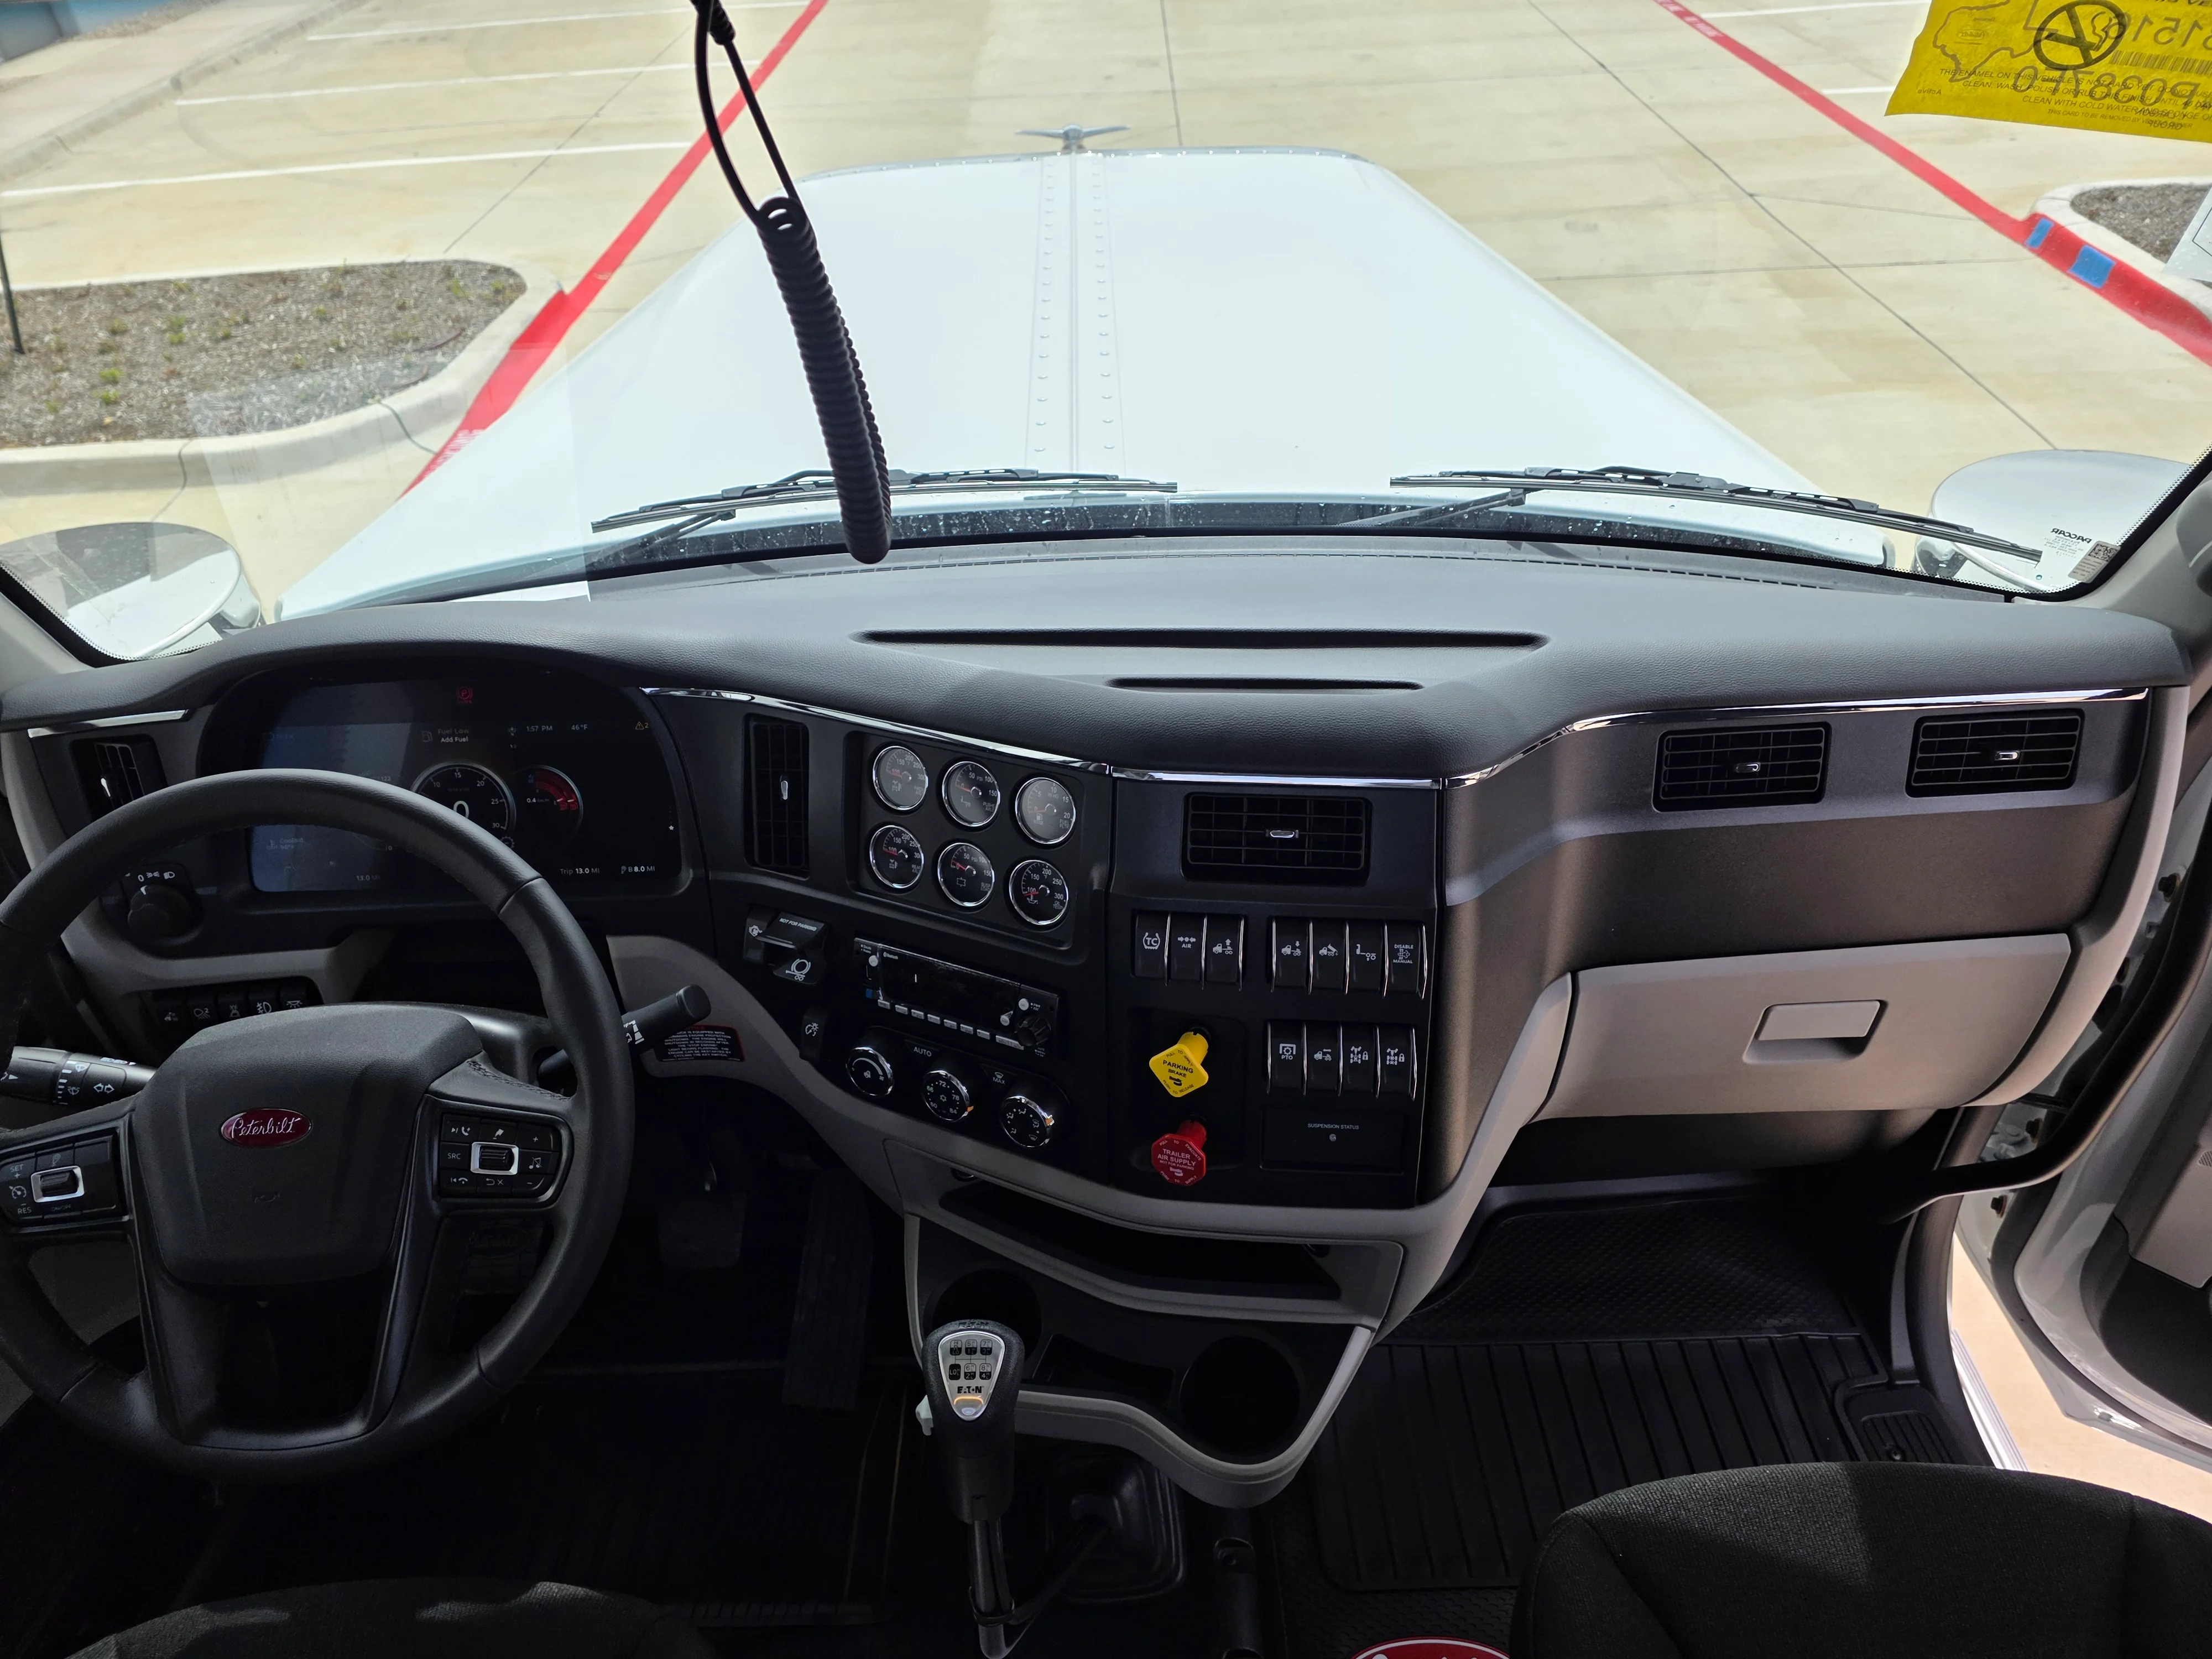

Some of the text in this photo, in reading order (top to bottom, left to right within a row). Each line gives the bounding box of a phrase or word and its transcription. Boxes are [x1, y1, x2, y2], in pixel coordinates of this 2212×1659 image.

[1958, 70, 1994, 78] ENAMEL
[2036, 75, 2074, 84] VEHICLE
[2107, 81, 2134, 89] HARD
[2026, 85, 2059, 93] POLISH
[2079, 89, 2096, 97] RUB
[2100, 91, 2120, 100] THIS
[2121, 93, 2152, 102] FINISH
[2023, 95, 2052, 105] CLEAN
[2054, 98, 2078, 107] WITH
[2106, 104, 2138, 113] WATER
[797, 922, 817, 931] PARKING
[914, 1047, 931, 1057] AUTO
[1163, 1060, 1193, 1073] PARKING
[1168, 1069, 1186, 1078] BRAKE
[1179, 1084, 1194, 1093] RELEASE
[232, 1117, 302, 1138] Peterbilt
[1162, 1149, 1191, 1159] TRAILER
[1185, 1144, 1202, 1161] EVACUATE
[1170, 1156, 1196, 1166] SUPPLY
[1185, 1176, 1197, 1184] SUPPLY
